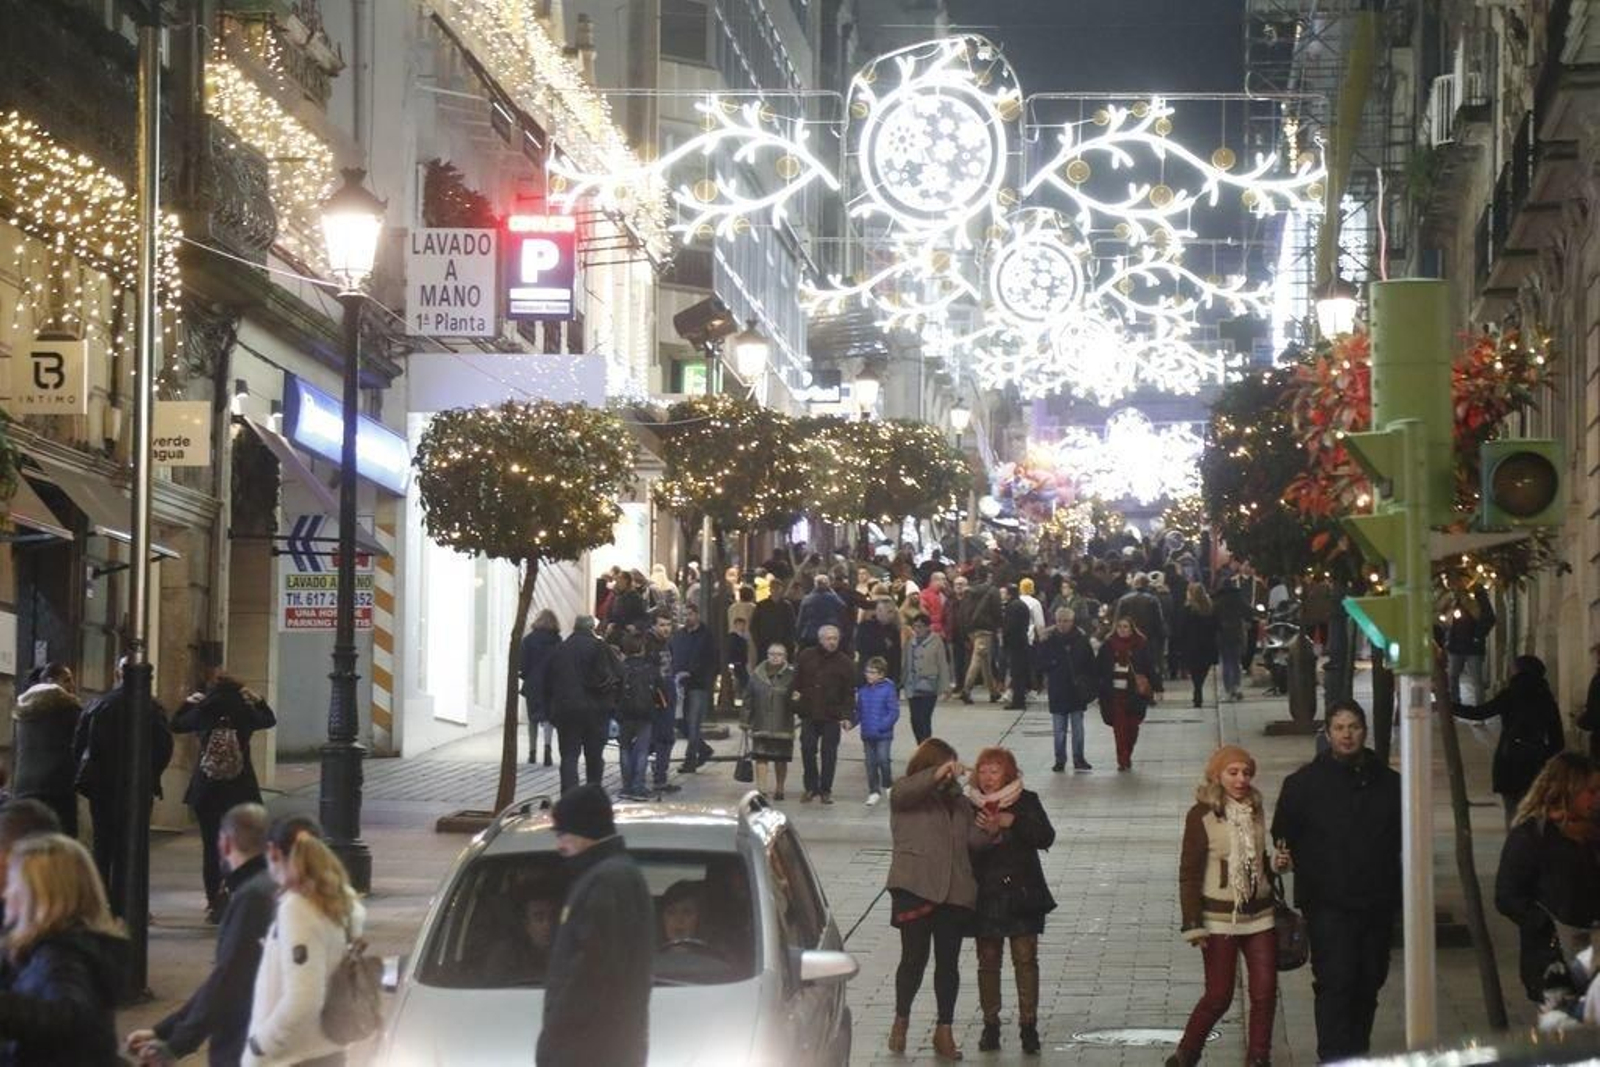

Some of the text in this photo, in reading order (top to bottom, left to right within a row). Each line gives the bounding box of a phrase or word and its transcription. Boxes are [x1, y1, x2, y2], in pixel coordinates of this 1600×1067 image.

[412, 233, 491, 255] LAVADO
[521, 239, 560, 283] P
[444, 259, 458, 281] A
[419, 285, 481, 308] MANO
[435, 313, 486, 332] Planta
[18, 394, 76, 404] INTIMO
[288, 576, 327, 588] LAVADO
[329, 576, 337, 588] A
[305, 592, 326, 606] 617
[294, 608, 316, 617] UNA
[287, 618, 331, 627] PARKING
